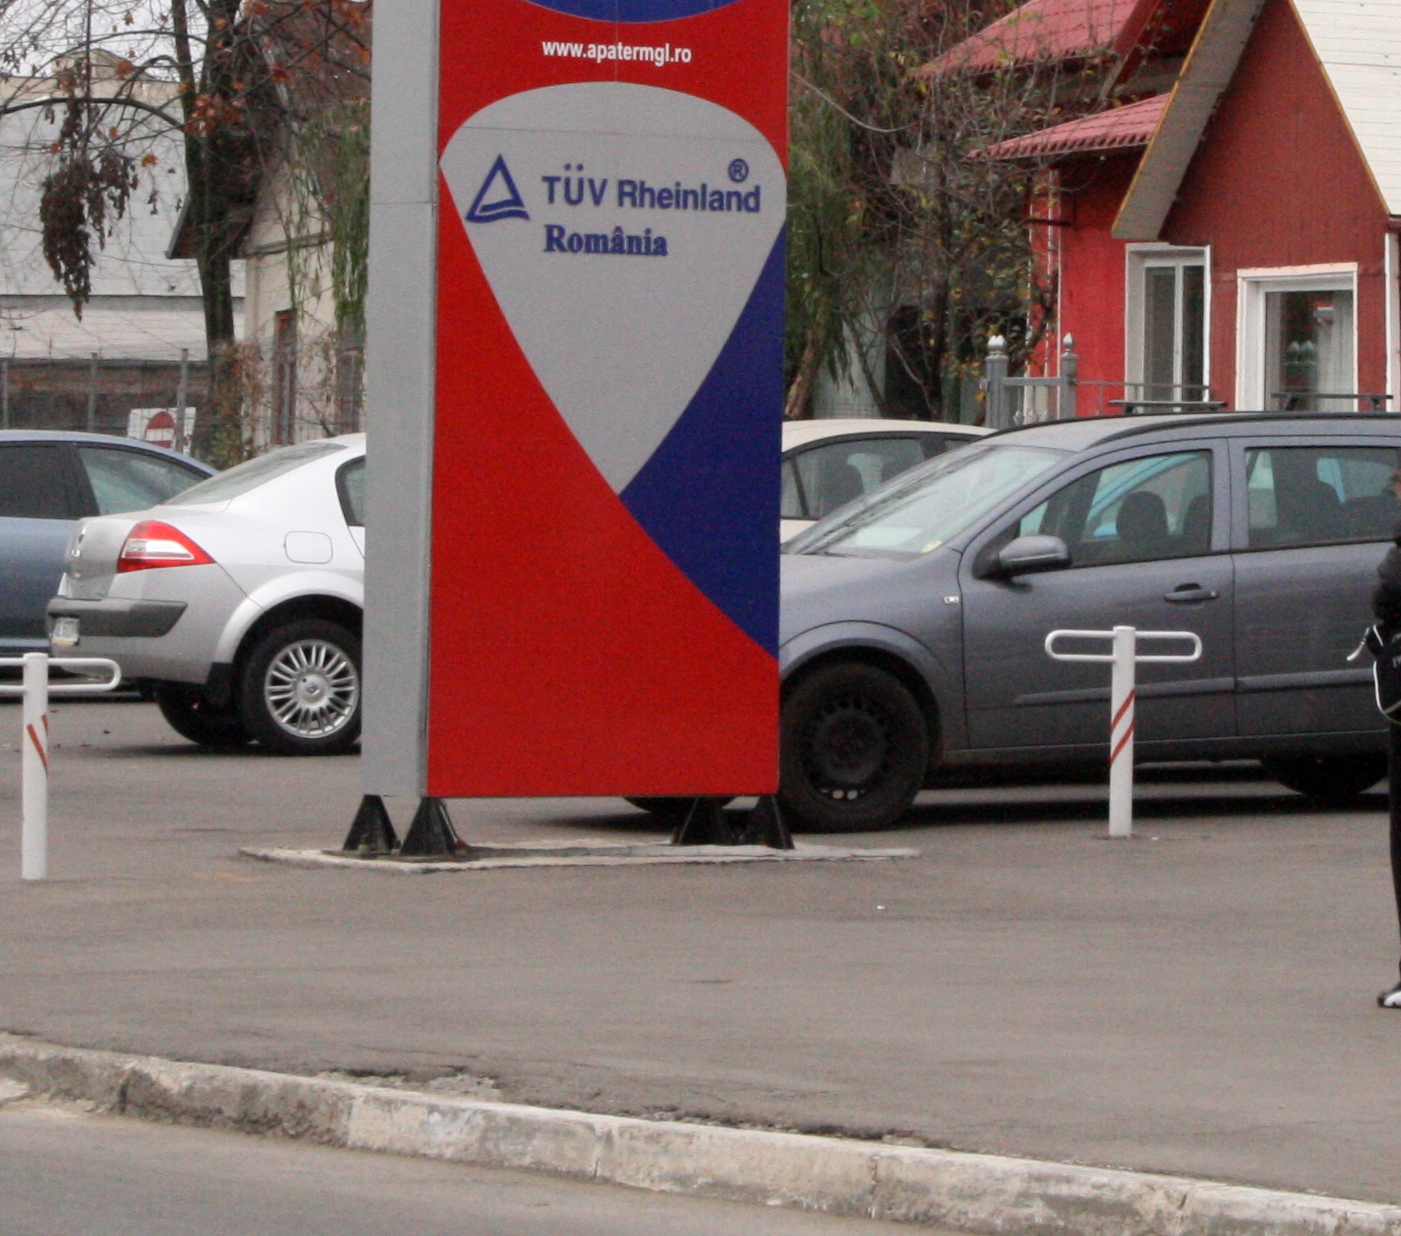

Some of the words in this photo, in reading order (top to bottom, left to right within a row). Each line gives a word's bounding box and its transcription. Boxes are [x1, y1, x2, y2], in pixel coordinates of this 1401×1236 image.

[541, 40, 692, 68] www.apatermgl.ro
[541, 163, 608, 207] TÜV
[616, 178, 762, 213] Rheinland
[543, 223, 669, 257] România
